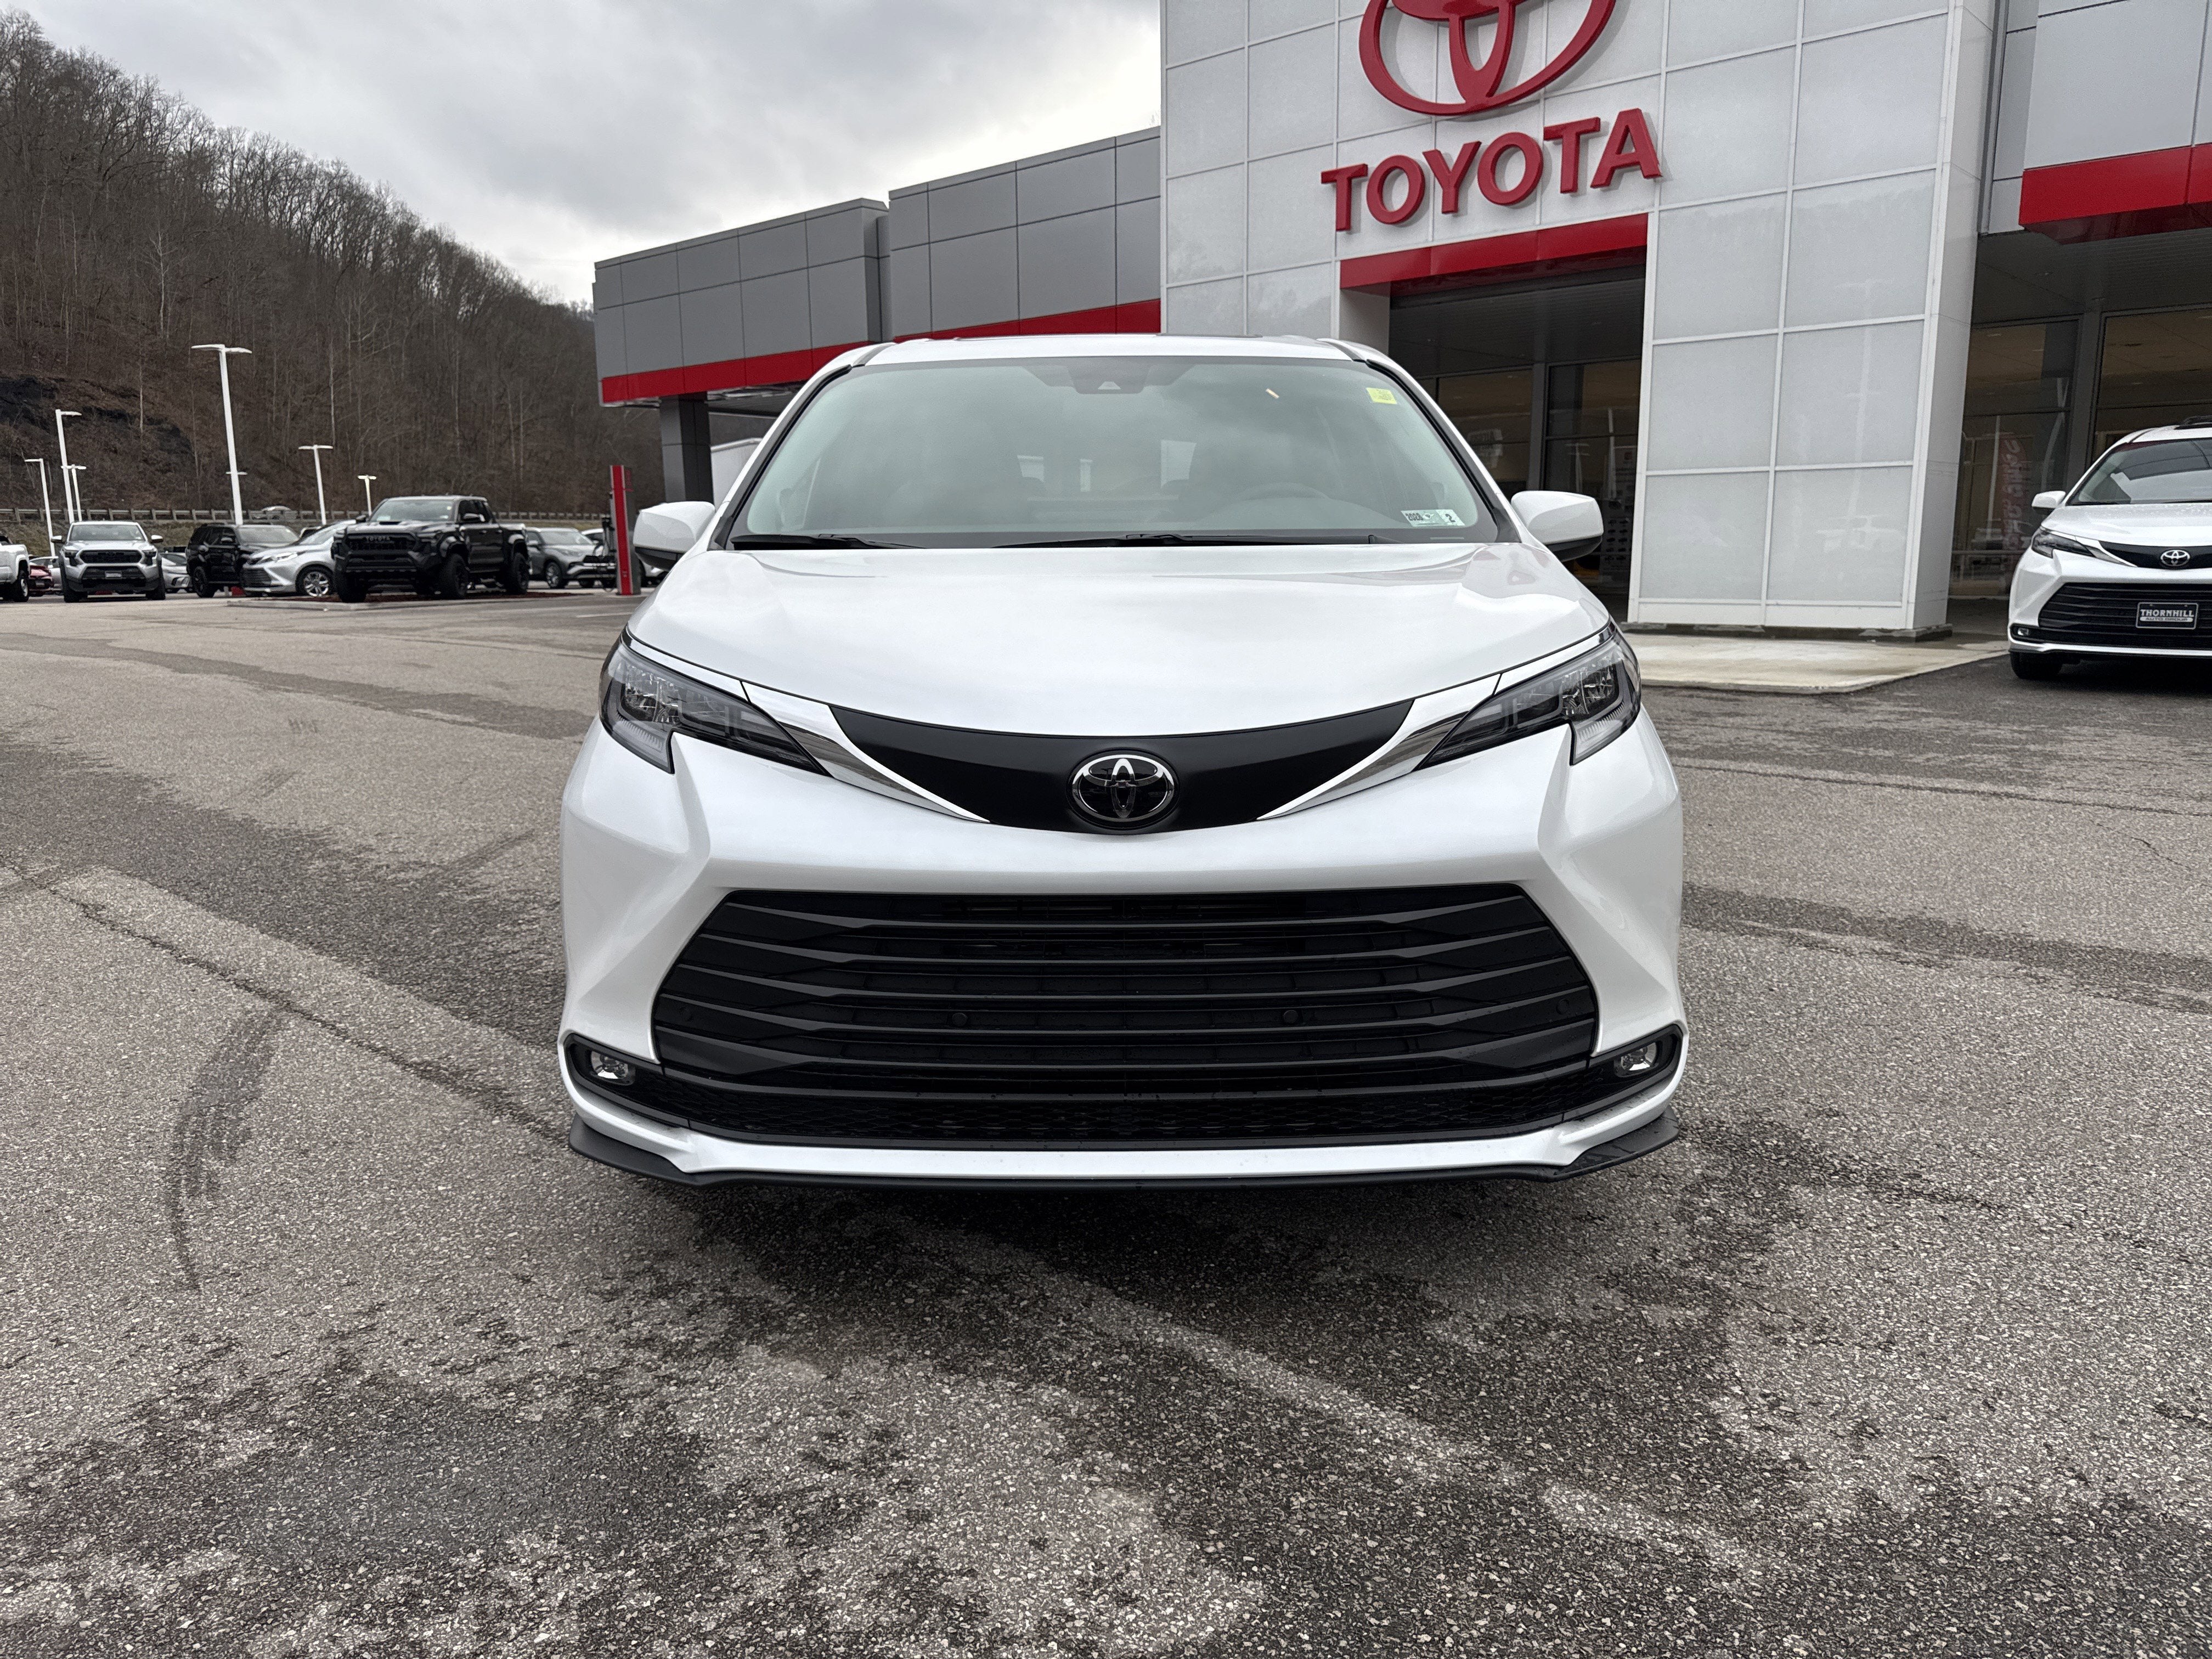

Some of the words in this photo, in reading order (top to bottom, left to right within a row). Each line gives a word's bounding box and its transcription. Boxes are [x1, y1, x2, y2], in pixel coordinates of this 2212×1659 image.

[1321, 108, 1662, 232] TOYOTA
[1445, 514, 1455, 523] 2
[2140, 609, 2194, 617] THORNHILL
